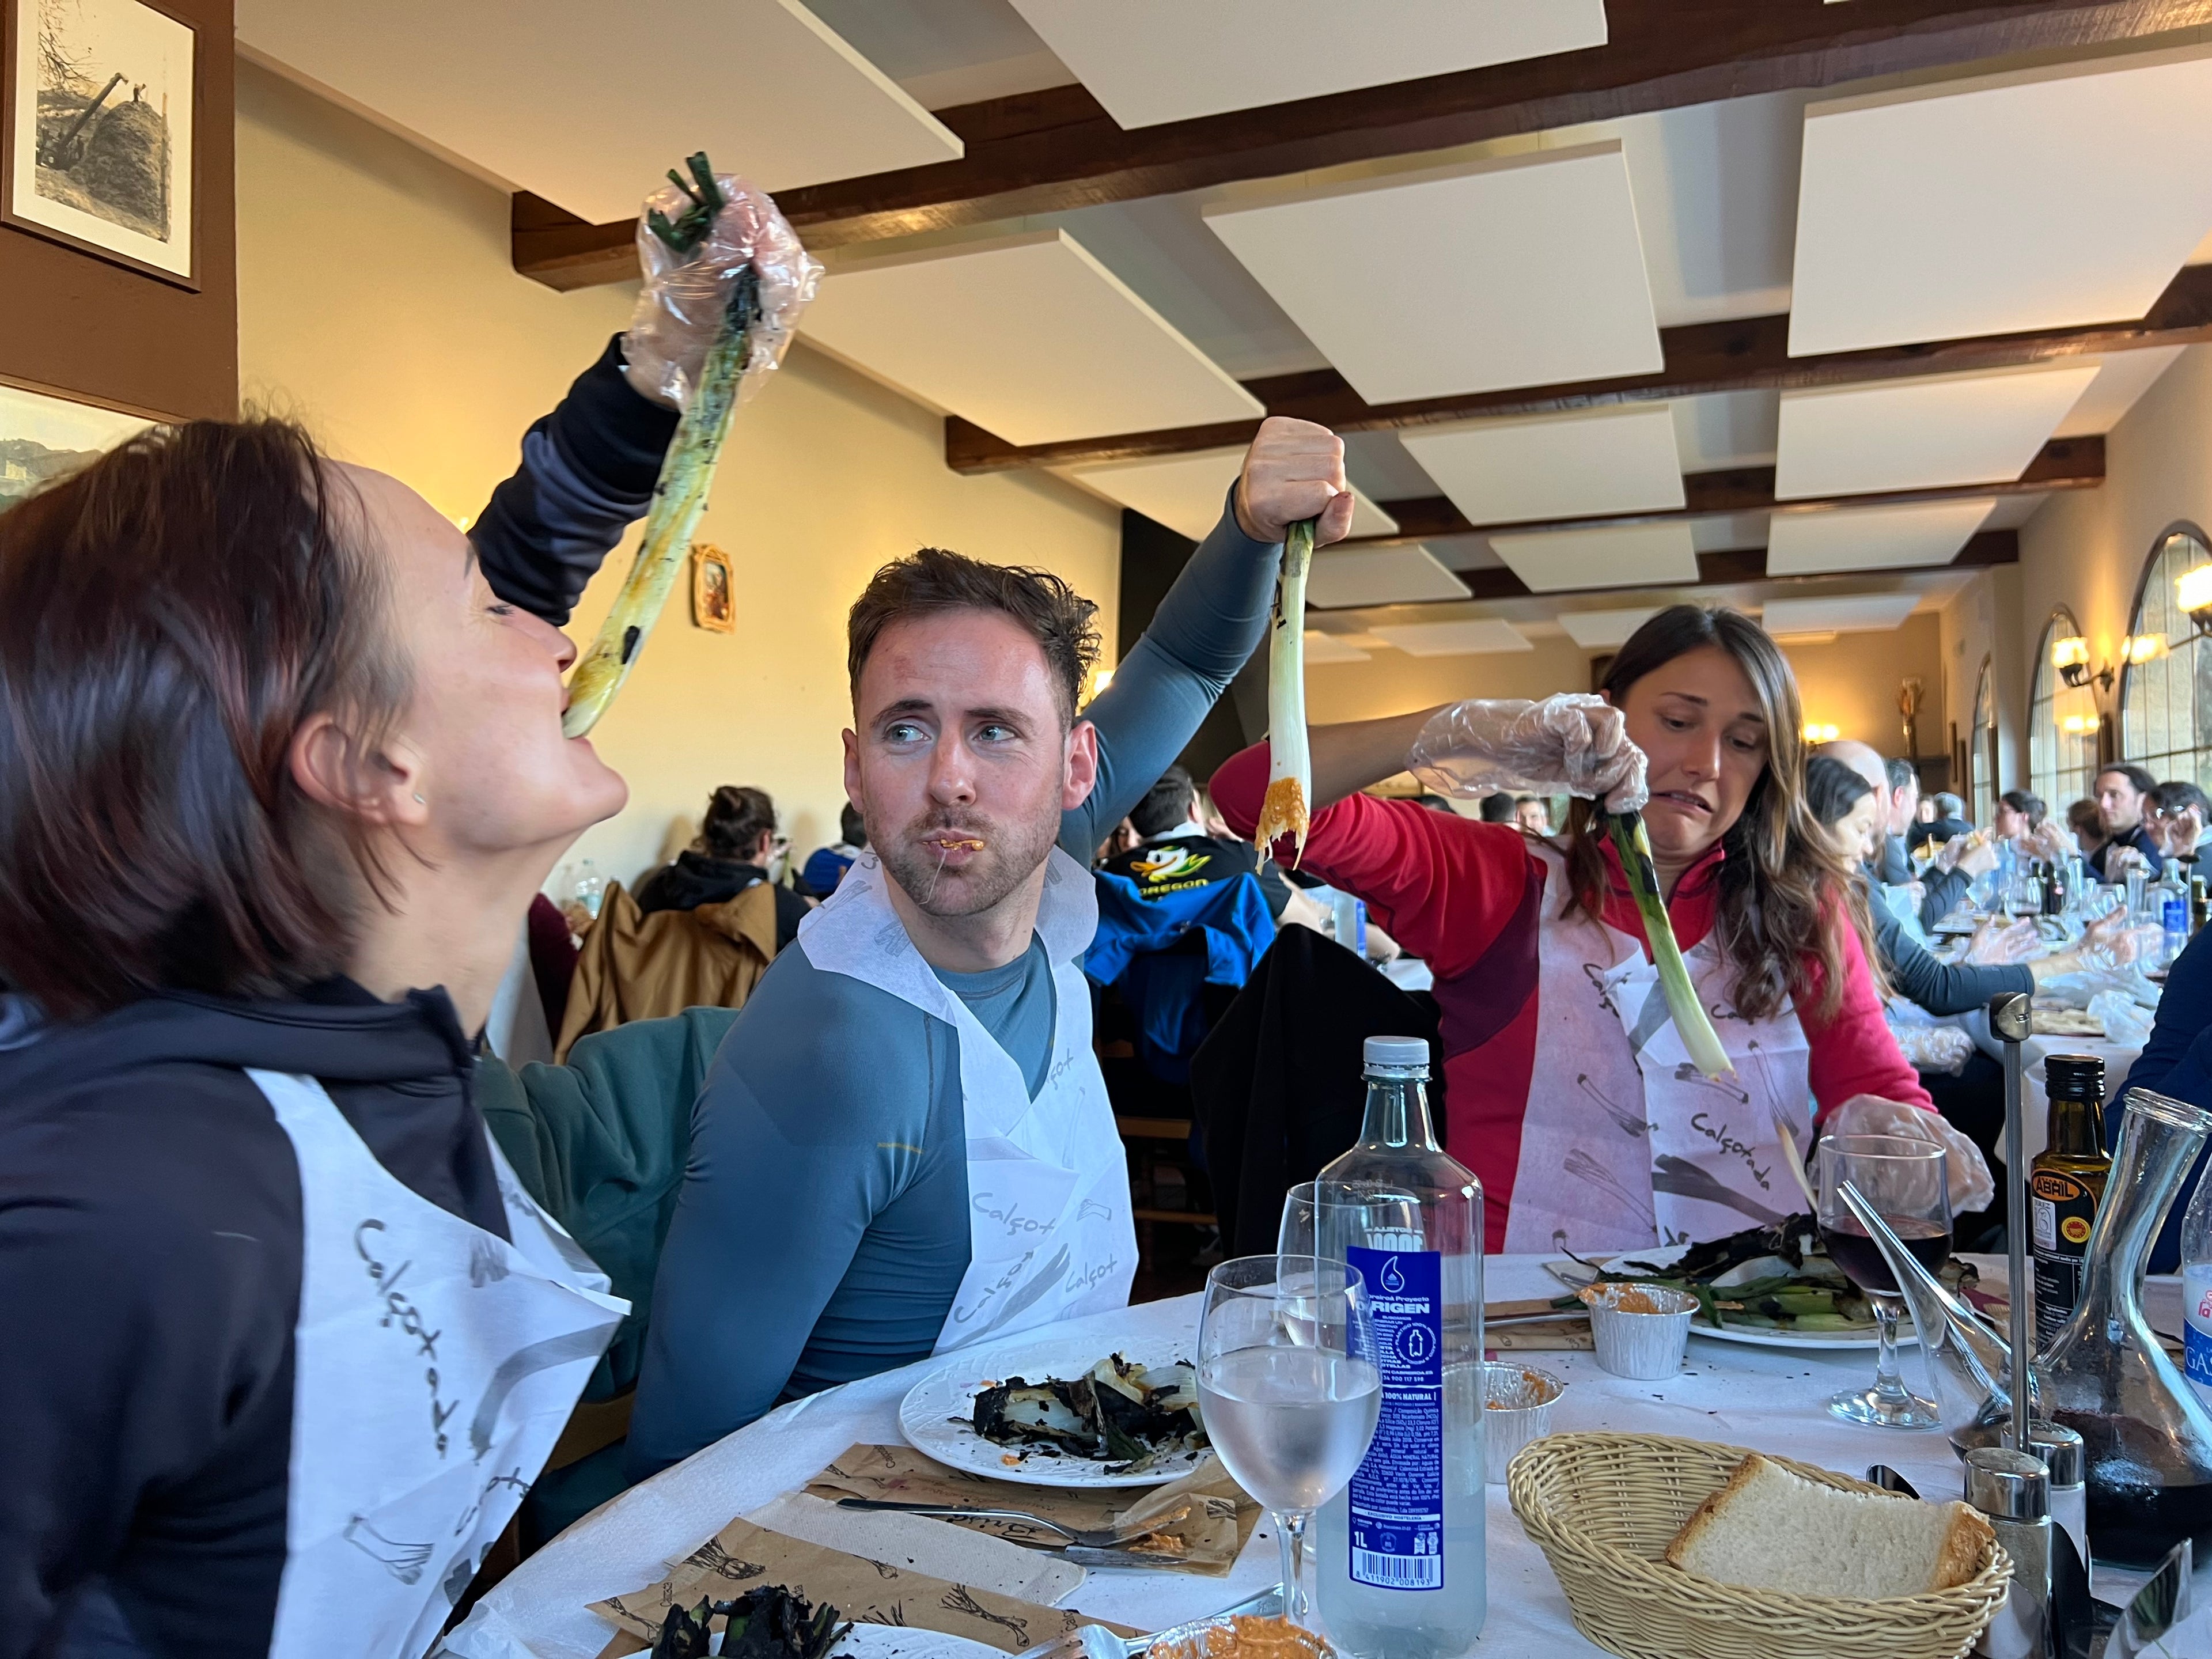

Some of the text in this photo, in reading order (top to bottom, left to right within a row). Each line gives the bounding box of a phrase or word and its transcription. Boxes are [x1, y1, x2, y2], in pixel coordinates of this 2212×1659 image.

[1138, 878, 1209, 896] OREGON
[1691, 1113, 1771, 1191] Calçotada
[2036, 1177, 2074, 1198] ABRIL
[972, 1192, 1056, 1236] Calçot
[1066, 1253, 1118, 1293] Calçot
[2186, 1346, 2212, 1376] GA
[1385, 1392, 1402, 1400] 100%
[1354, 1531, 1367, 1548] 1L
